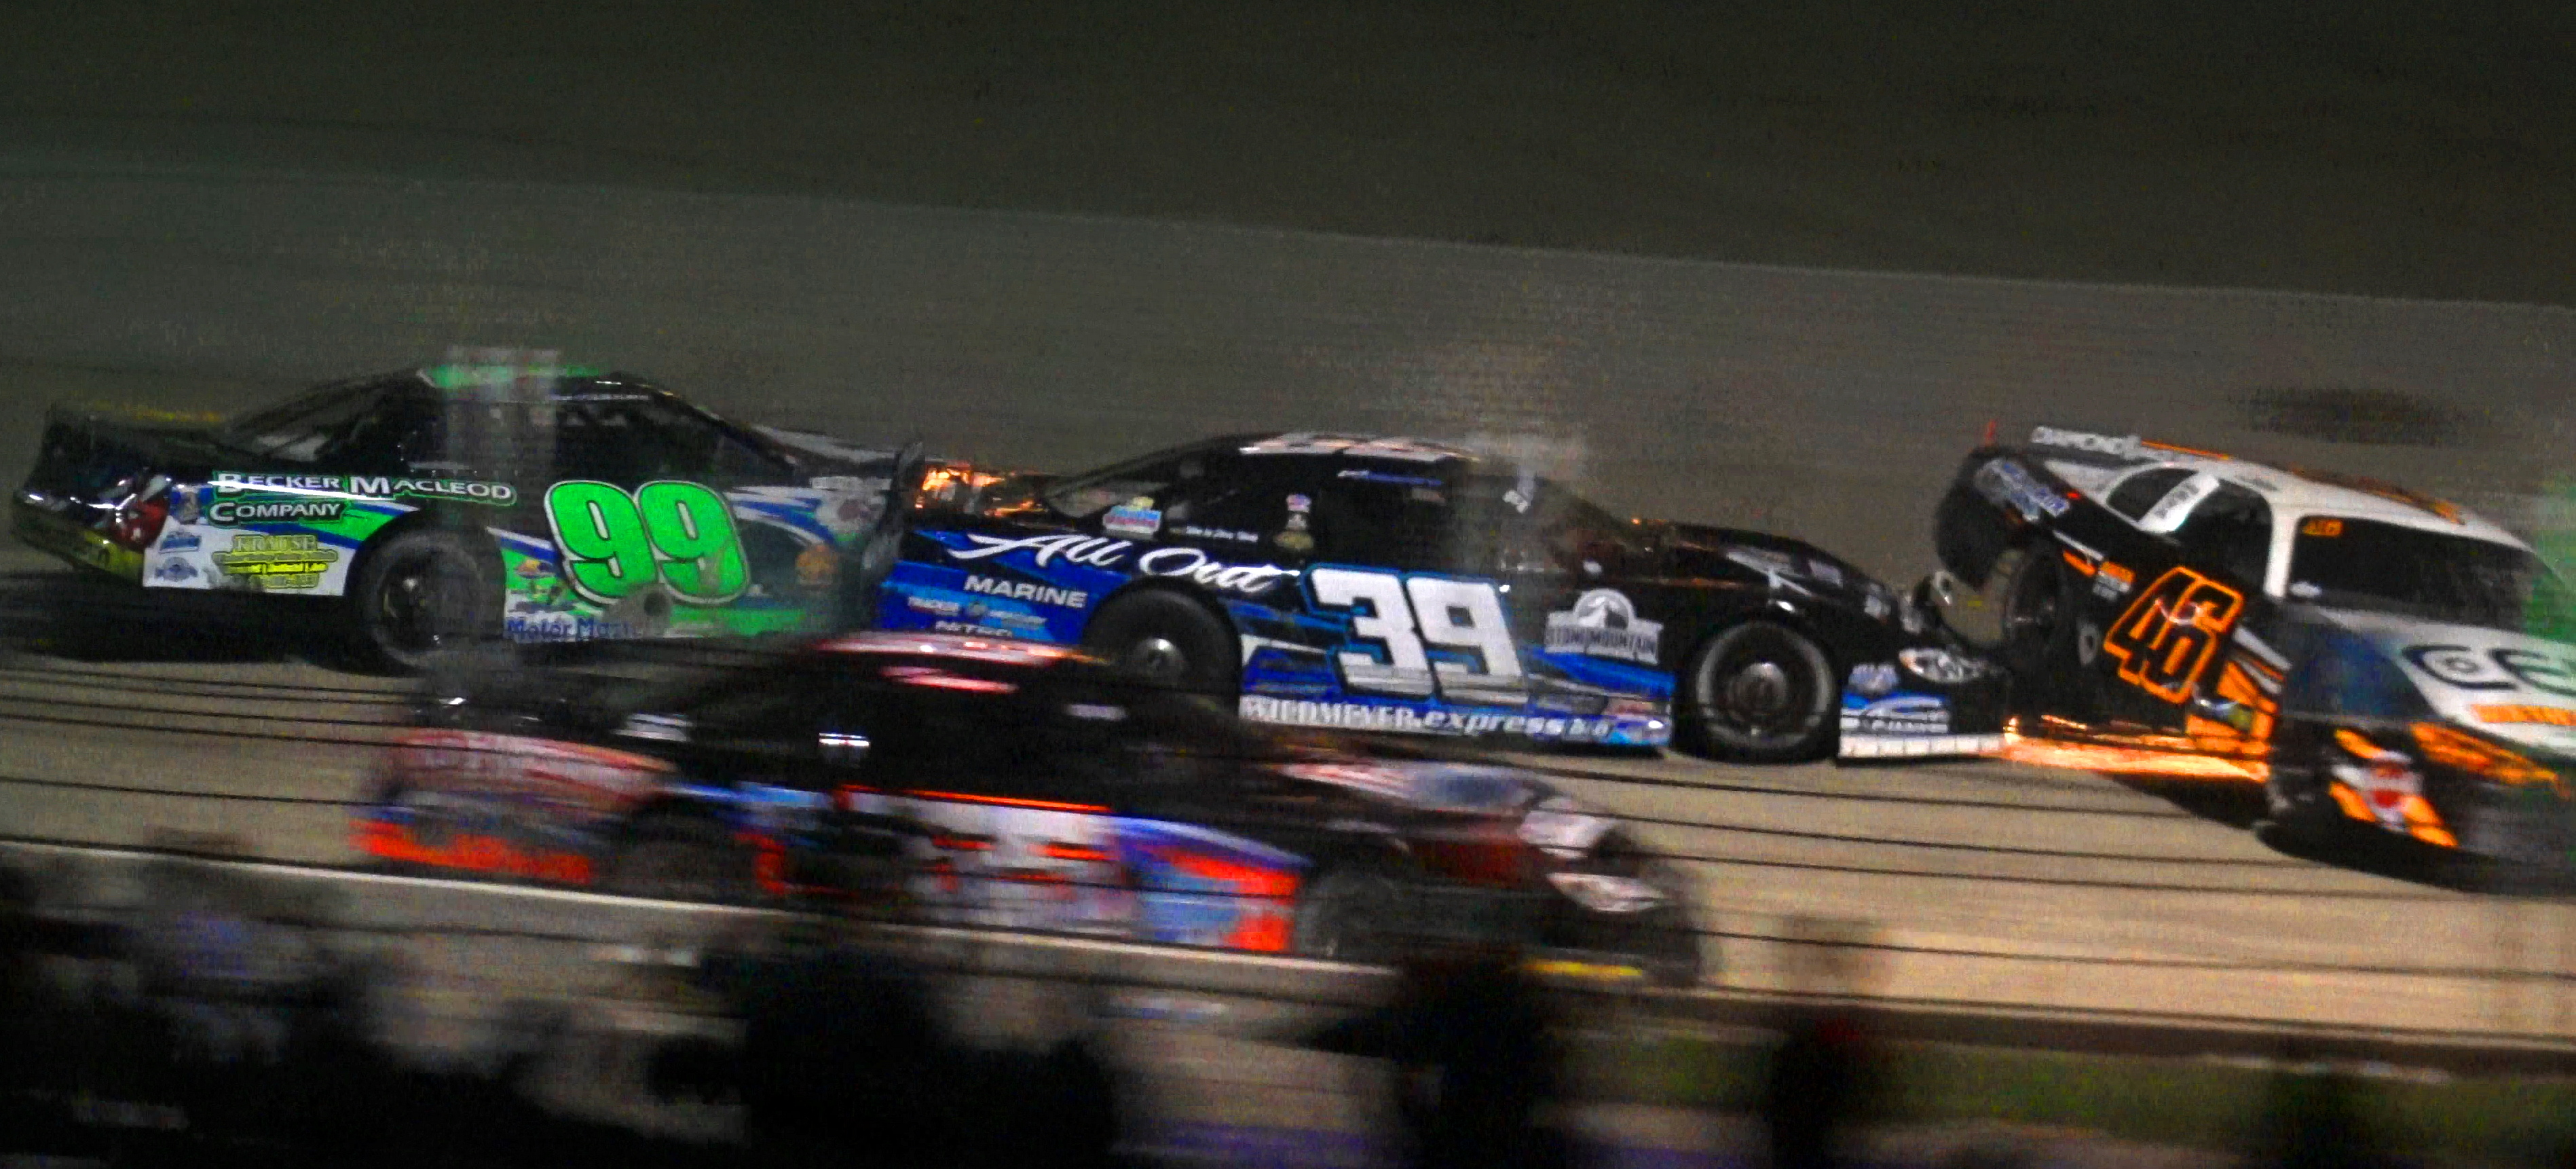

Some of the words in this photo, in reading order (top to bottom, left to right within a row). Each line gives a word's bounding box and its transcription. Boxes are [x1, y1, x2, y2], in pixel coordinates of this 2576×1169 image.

[217, 473, 339, 493] BECKER
[350, 477, 511, 498] MACLEOD
[209, 502, 340, 521] COMPANY
[545, 479, 751, 604] 99
[948, 534, 1132, 568] All
[964, 575, 1088, 608] MARINE
[1305, 564, 1531, 707] 39
[2104, 565, 2245, 704] 46
